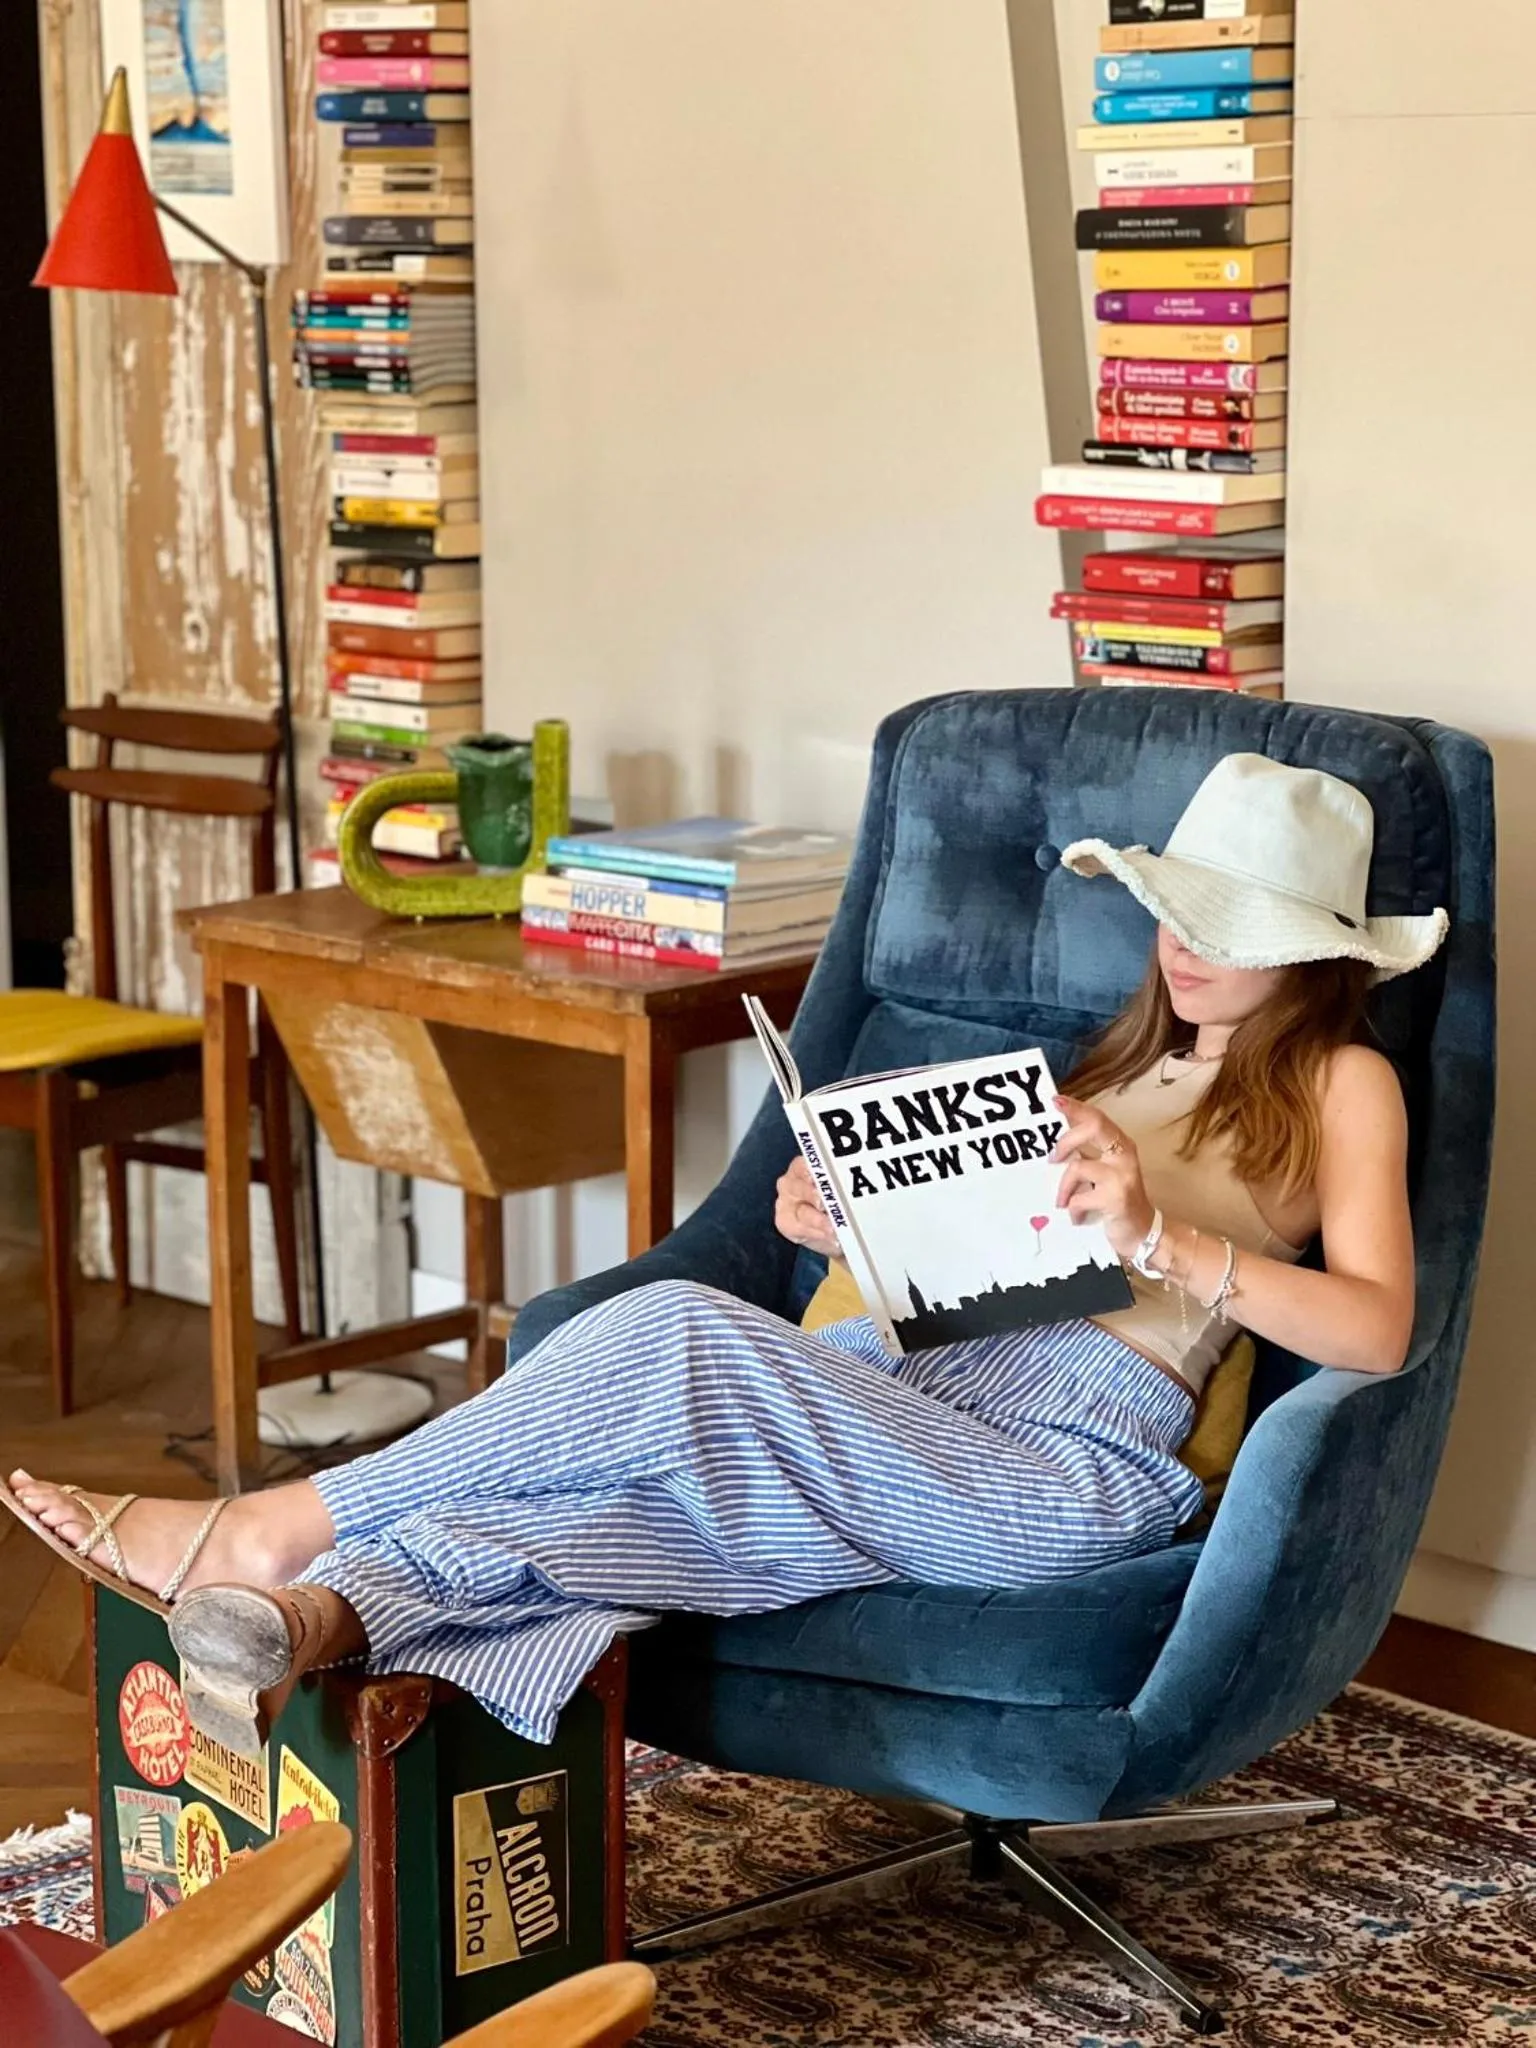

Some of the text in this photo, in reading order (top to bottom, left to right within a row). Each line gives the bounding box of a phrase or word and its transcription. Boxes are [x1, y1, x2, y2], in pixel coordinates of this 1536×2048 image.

[571, 884, 646, 917] HOPPER
[819, 1065, 1047, 1158] BANKSY
[798, 1131, 823, 1169] BANKSY
[819, 1179, 836, 1201] NEW
[828, 1202, 848, 1228] YORK
[850, 1121, 1064, 1198] A NEW YORK
[122, 1666, 184, 1719] ATLANTIC
[140, 1742, 185, 1782] HOTEL
[189, 1725, 265, 1794] CONTINENTAL
[229, 1778, 265, 1822] HOTEL
[466, 1856, 492, 1957] Praha
[497, 1820, 560, 1949] ALCRON
